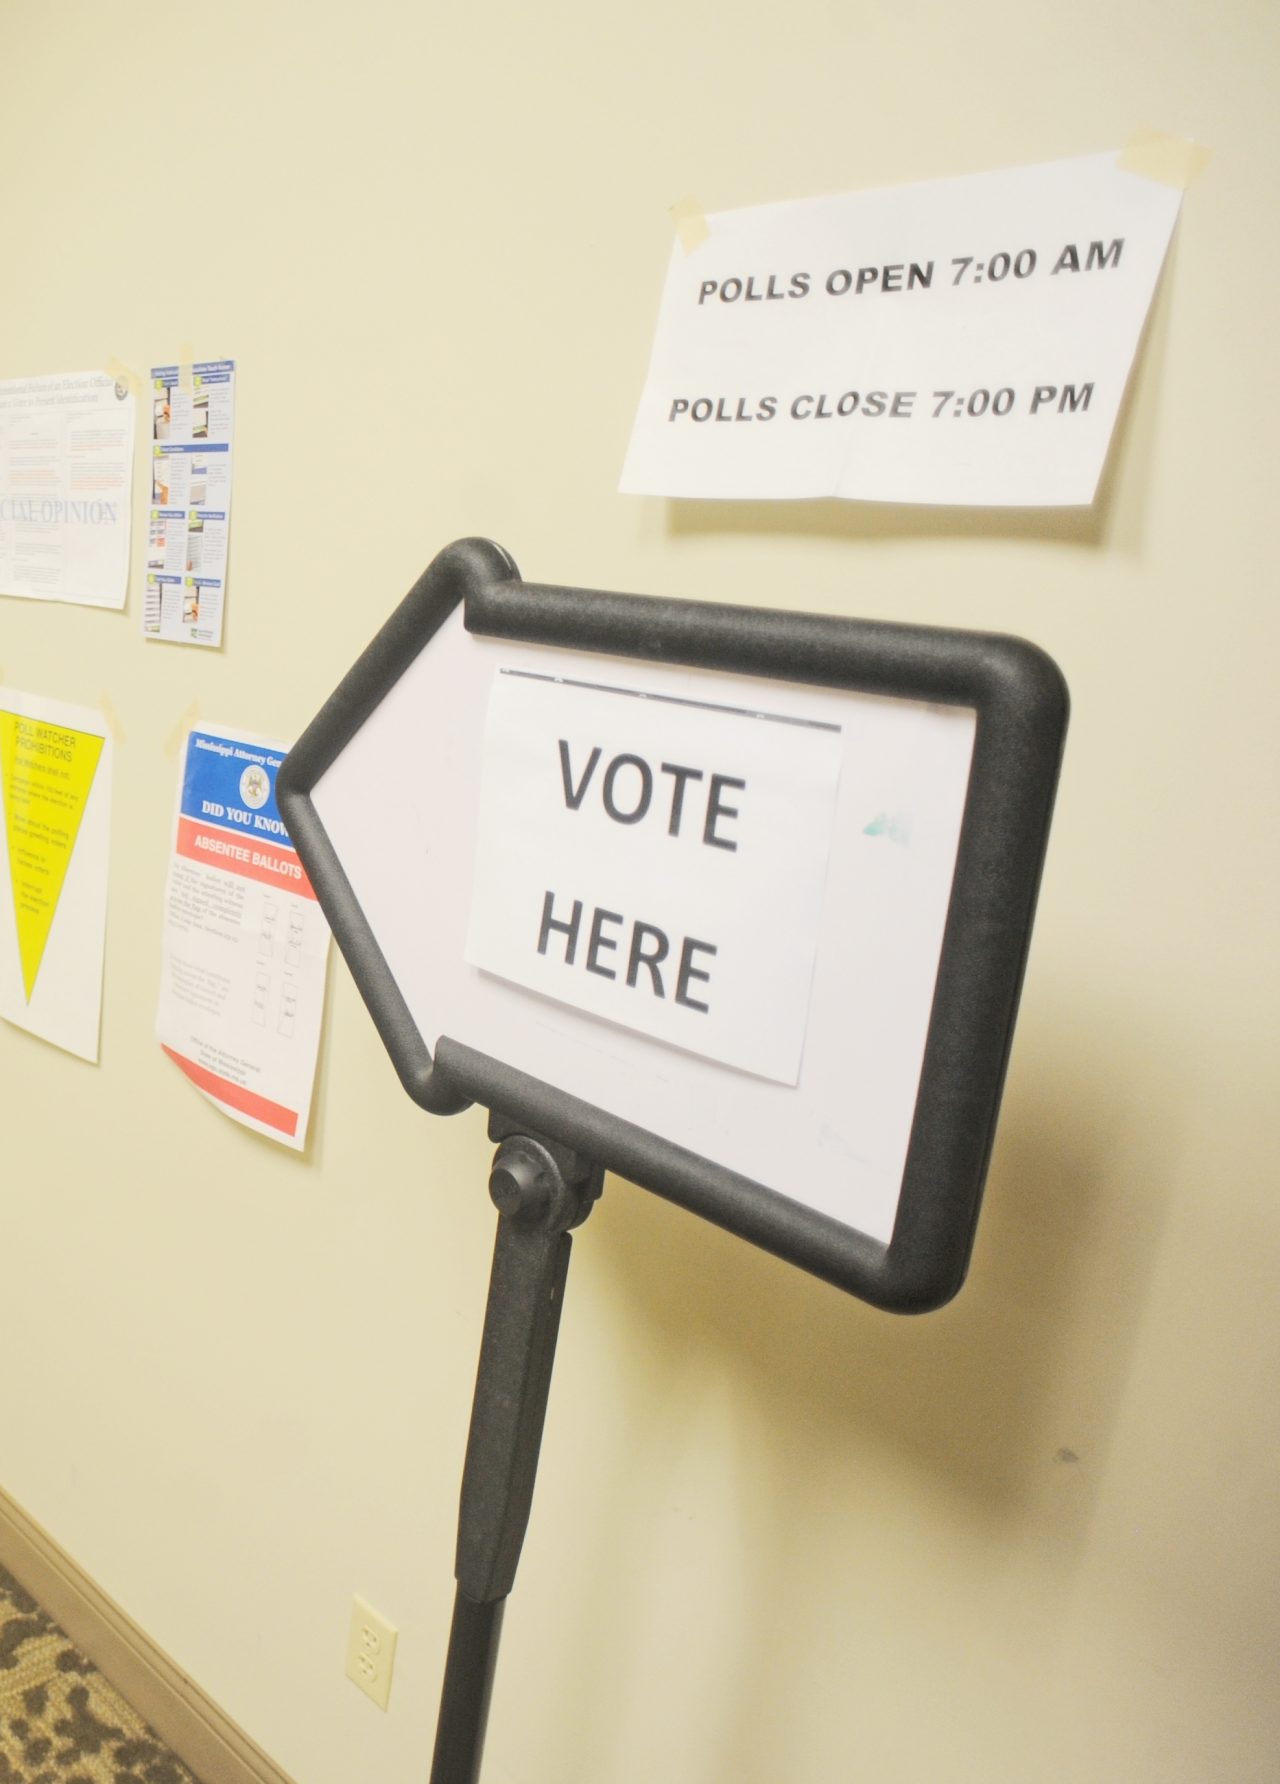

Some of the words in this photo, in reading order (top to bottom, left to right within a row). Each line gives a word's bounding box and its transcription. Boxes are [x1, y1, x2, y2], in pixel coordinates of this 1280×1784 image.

[698, 272, 810, 305] POLLS
[825, 261, 934, 296] OPEN
[950, 248, 1037, 286] 7:00
[1049, 238, 1126, 276] AM
[668, 396, 777, 423] POLLS
[789, 391, 917, 420] CLOSE
[930, 387, 1016, 419] 7:00
[1028, 382, 1095, 415] PM
[40, 498, 118, 525] OPINION
[15, 720, 34, 737] POLL
[35, 727, 76, 748] WATCHER
[15, 735, 73, 762] PROHIBITIONS
[195, 738, 233, 758] Mississippi
[234, 748, 267, 767] Attorney
[202, 800, 224, 818] DID
[226, 806, 252, 826] YOU
[557, 738, 746, 853] VOTE
[194, 834, 250, 864] ABSENTEE
[252, 851, 302, 880] BALLOTS
[536, 890, 718, 1015] HERE
